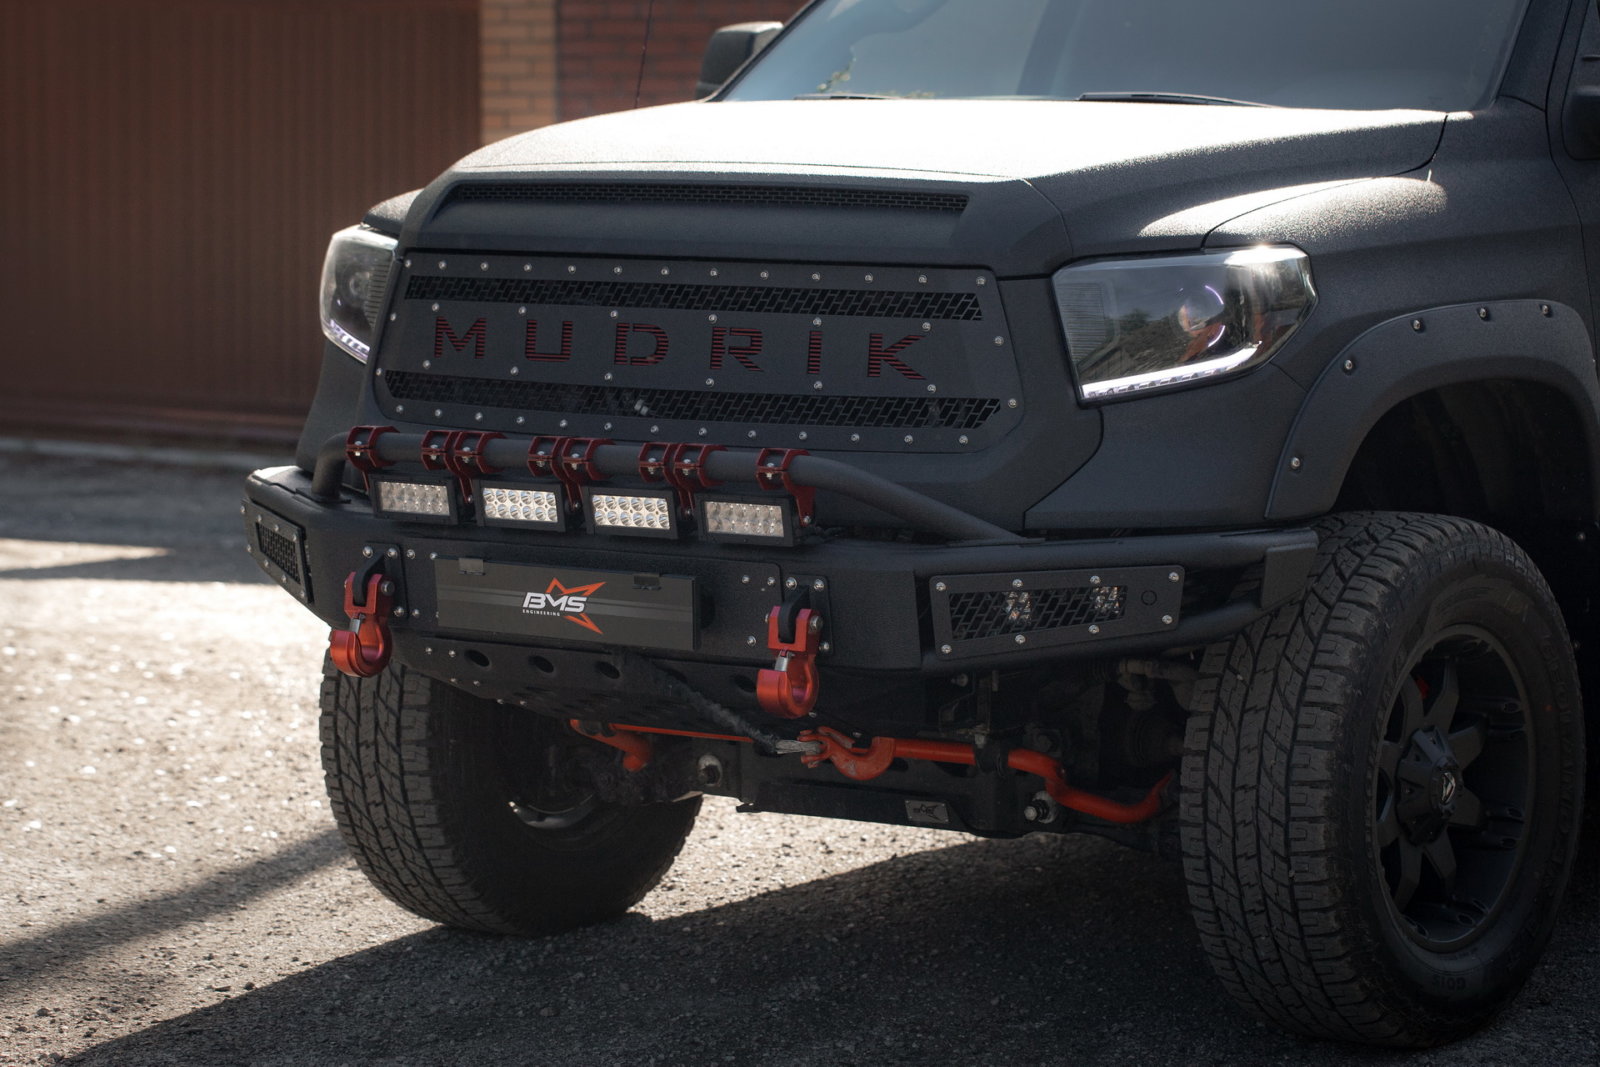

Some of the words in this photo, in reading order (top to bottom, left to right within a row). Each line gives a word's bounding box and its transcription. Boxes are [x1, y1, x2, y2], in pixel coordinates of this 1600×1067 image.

[434, 316, 927, 380] MUDRIK
[522, 592, 587, 612] BMS
[522, 609, 560, 617] ENGINEERING
